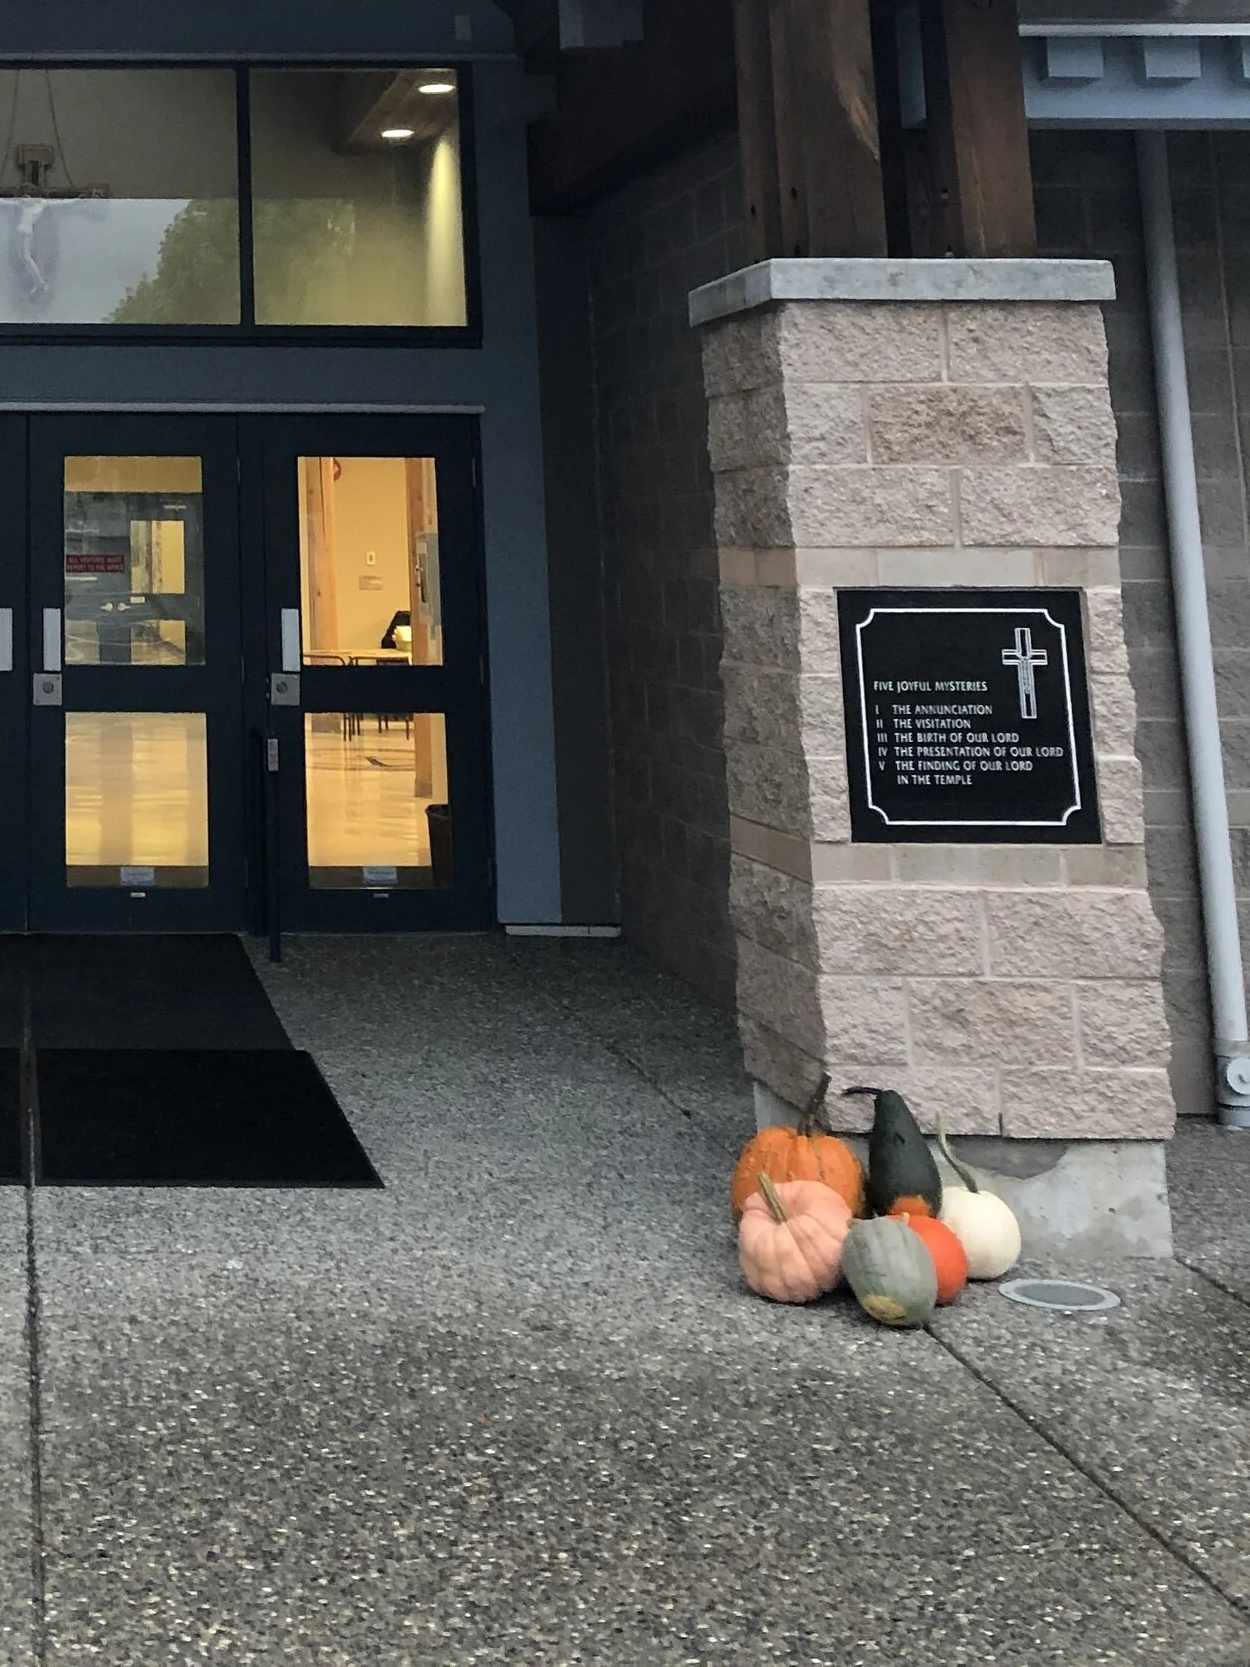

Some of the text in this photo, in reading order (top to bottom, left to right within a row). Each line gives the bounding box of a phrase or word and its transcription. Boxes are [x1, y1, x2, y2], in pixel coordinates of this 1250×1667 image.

[874, 681, 988, 694] FIVE JOYFUL MYSTERIES
[875, 705, 993, 715] I THE ANNUNCIATION
[876, 719, 971, 729] II THE VISITATION
[877, 733, 1019, 743] III THE BIRTH OF OUR LORD
[878, 747, 1064, 757] IV THE PRESENTATION OF OUR LORD
[878, 761, 1033, 771] V THE FINDING OF OUR LORD
[897, 774, 972, 785] IN THE TEMPLE
